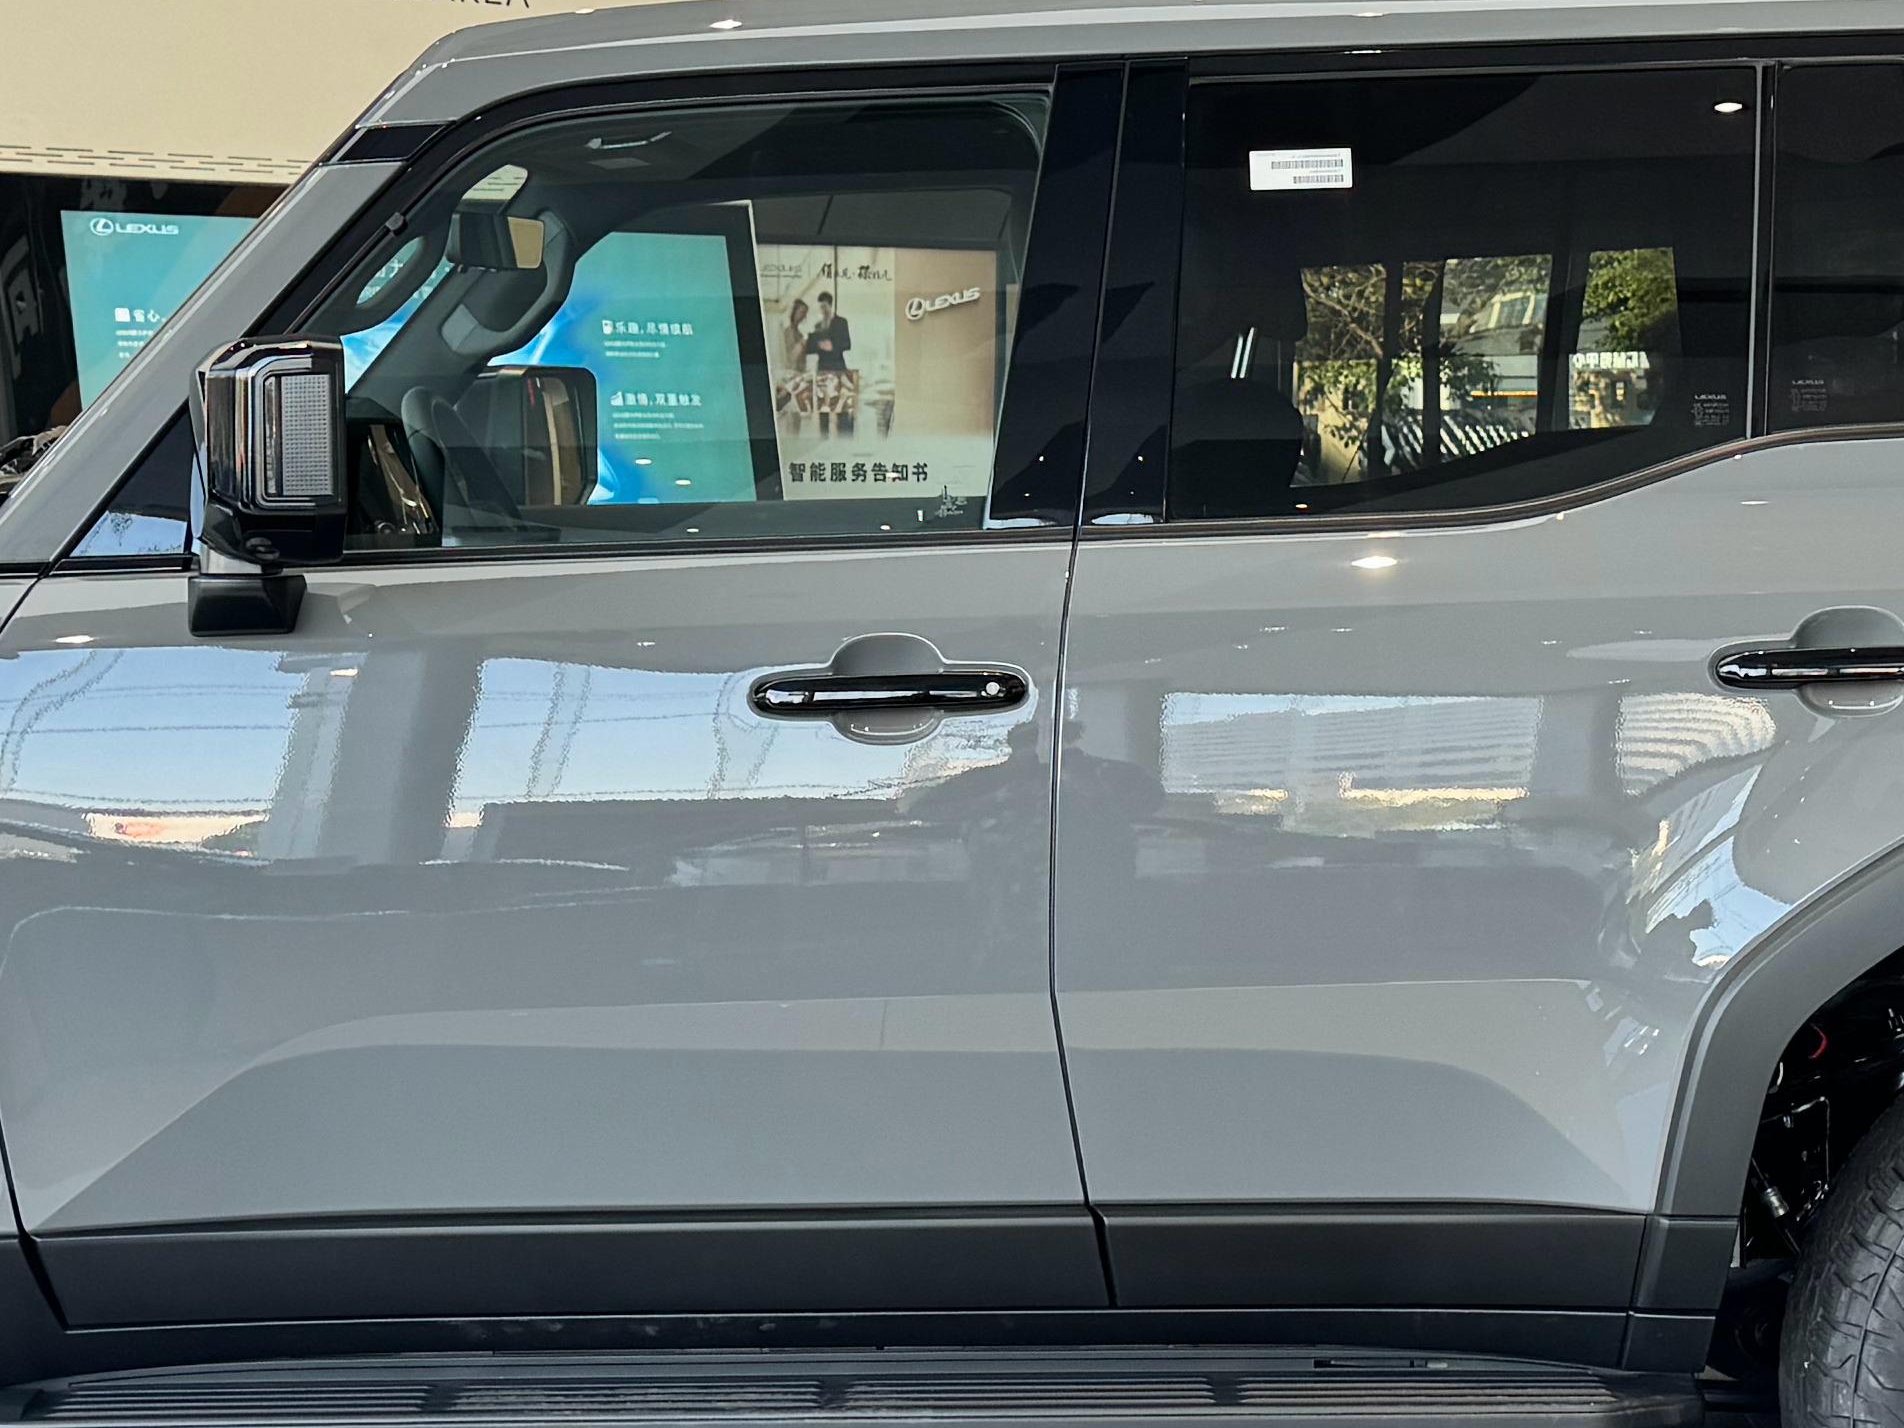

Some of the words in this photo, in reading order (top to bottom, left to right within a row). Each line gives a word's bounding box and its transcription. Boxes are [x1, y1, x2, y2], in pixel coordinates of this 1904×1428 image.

[116, 224, 179, 235] LEXUS
[925, 287, 982, 312] LEXUS
[788, 461, 929, 483] 智能服务告知书
